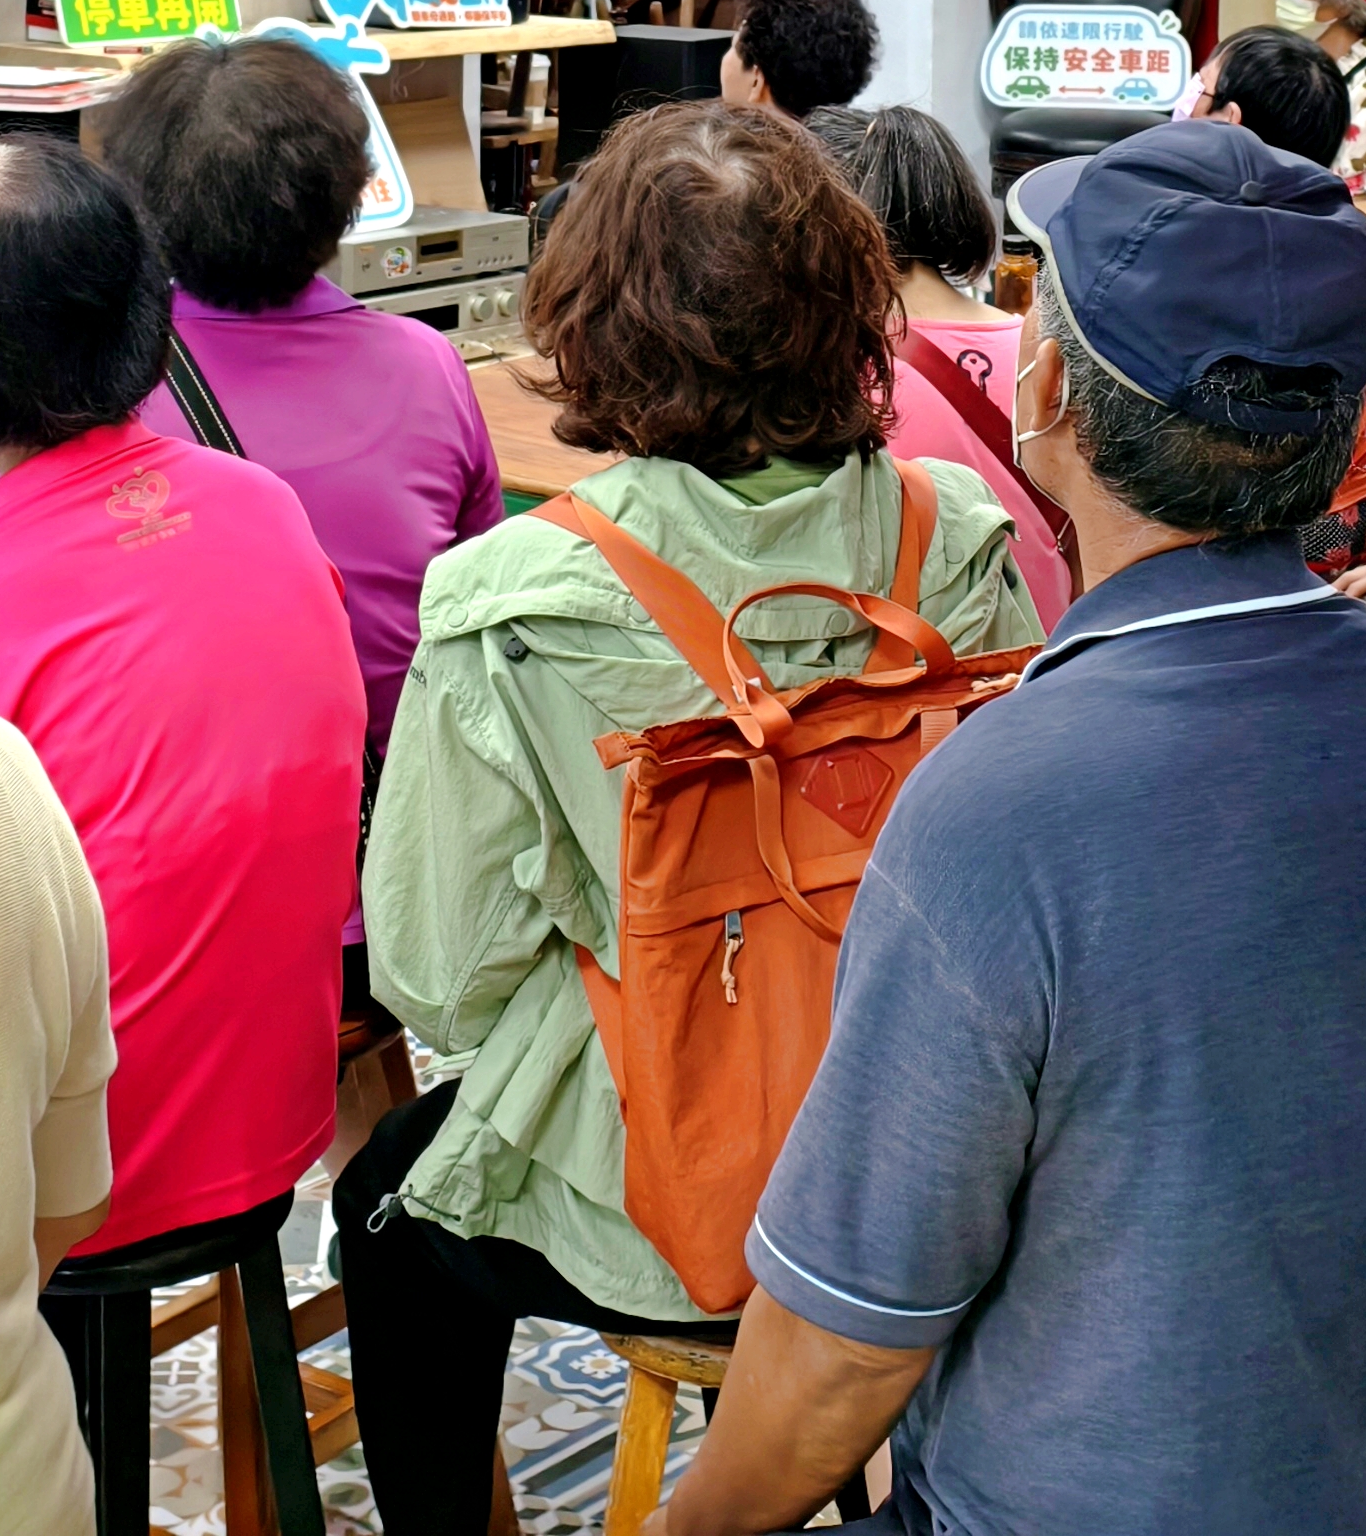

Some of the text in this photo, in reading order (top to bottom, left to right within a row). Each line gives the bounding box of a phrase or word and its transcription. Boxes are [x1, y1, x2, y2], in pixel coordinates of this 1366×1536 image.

[1018, 20, 1144, 41] 請依速限行駛
[1003, 46, 1171, 74] 保持安全車距
